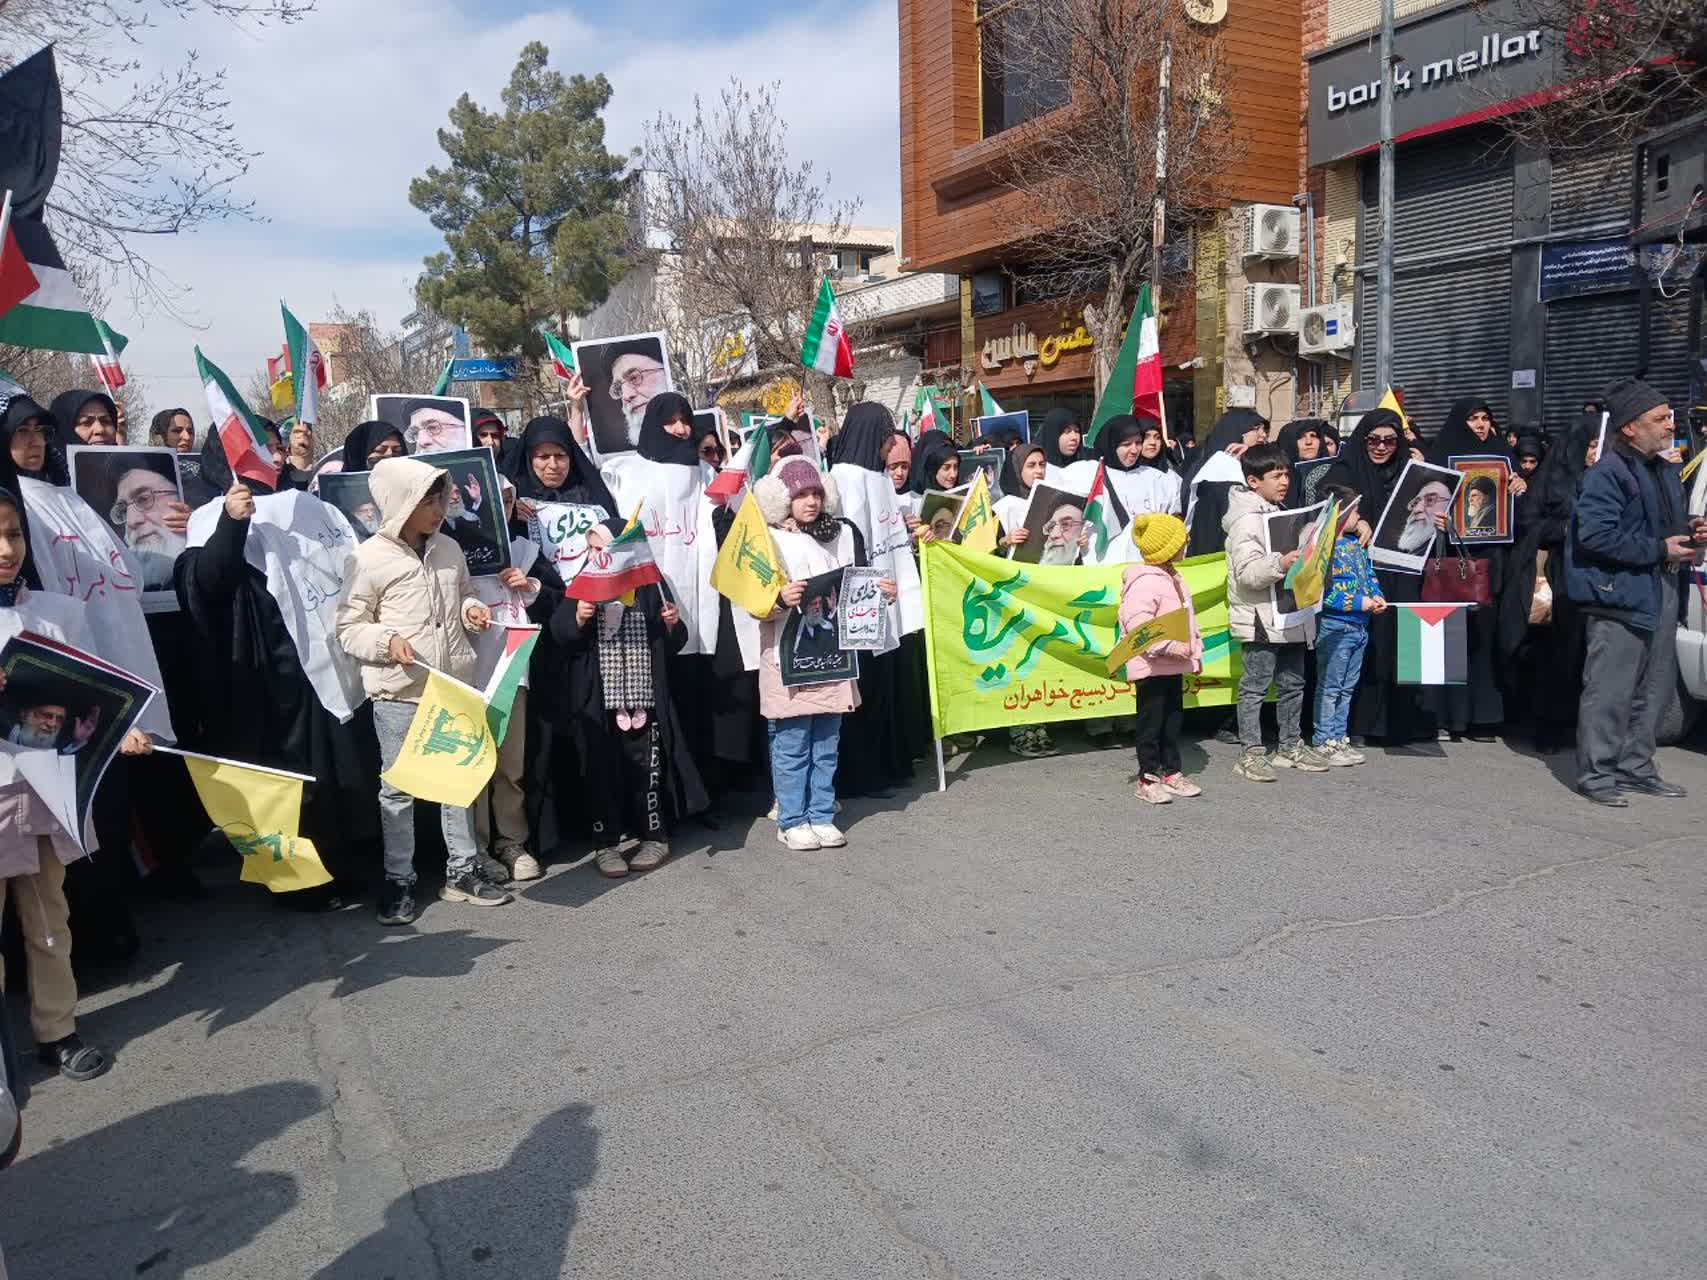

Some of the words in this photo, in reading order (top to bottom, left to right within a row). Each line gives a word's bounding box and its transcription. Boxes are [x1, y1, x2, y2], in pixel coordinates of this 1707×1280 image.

[1328, 63, 1411, 112] bank
[1422, 30, 1541, 84] mellat
[547, 509, 593, 544] خدای
[1003, 679, 1069, 711] خواهران
[1069, 683, 1106, 709] بسیج
